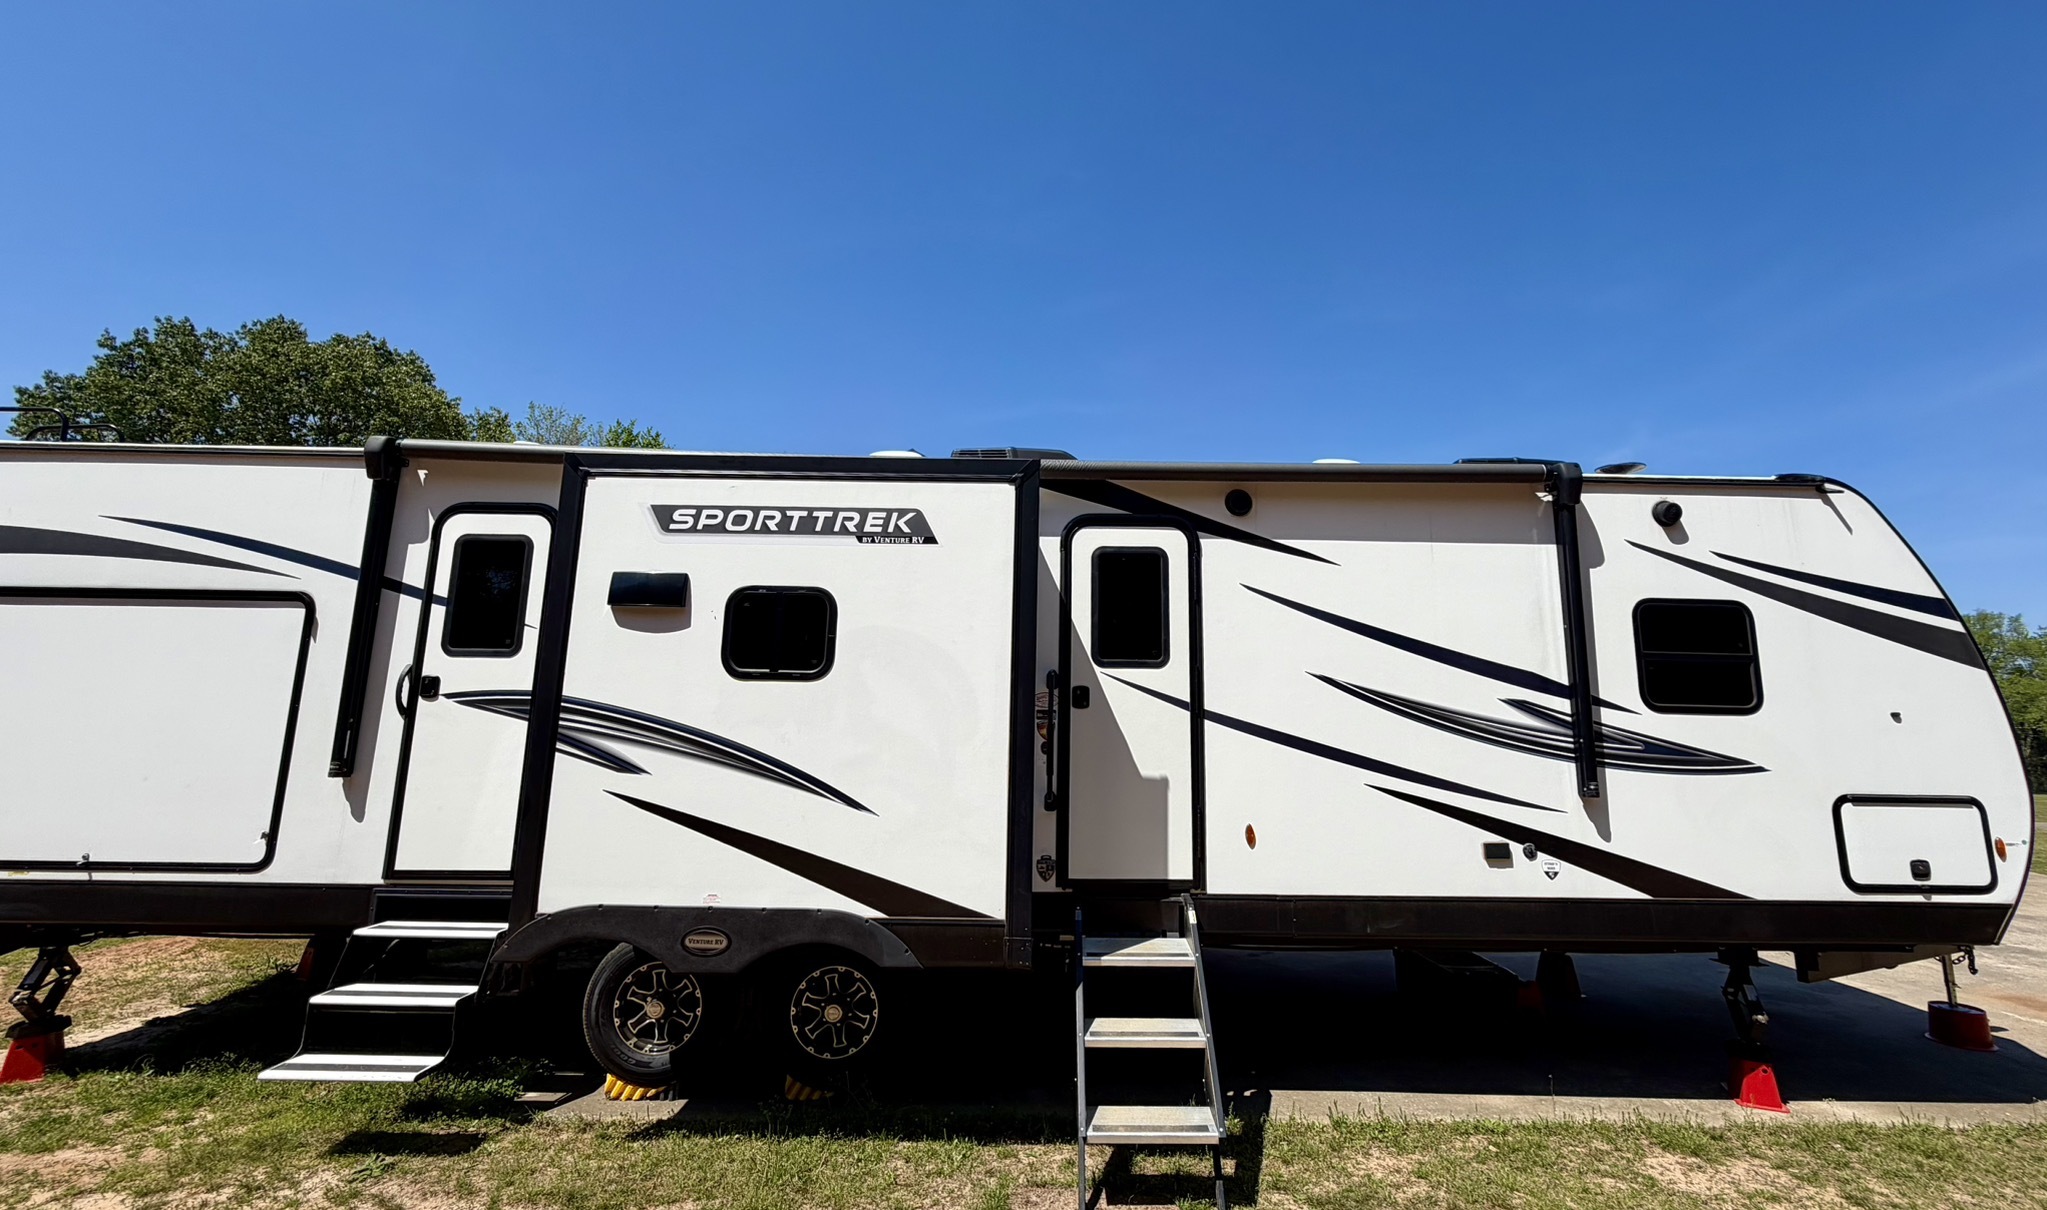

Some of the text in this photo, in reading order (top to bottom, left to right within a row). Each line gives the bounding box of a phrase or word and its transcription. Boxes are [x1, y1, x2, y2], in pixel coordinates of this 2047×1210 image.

[668, 509, 917, 533] SPORTTREK
[874, 536, 910, 544] VENTURE
[911, 536, 925, 544] RV
